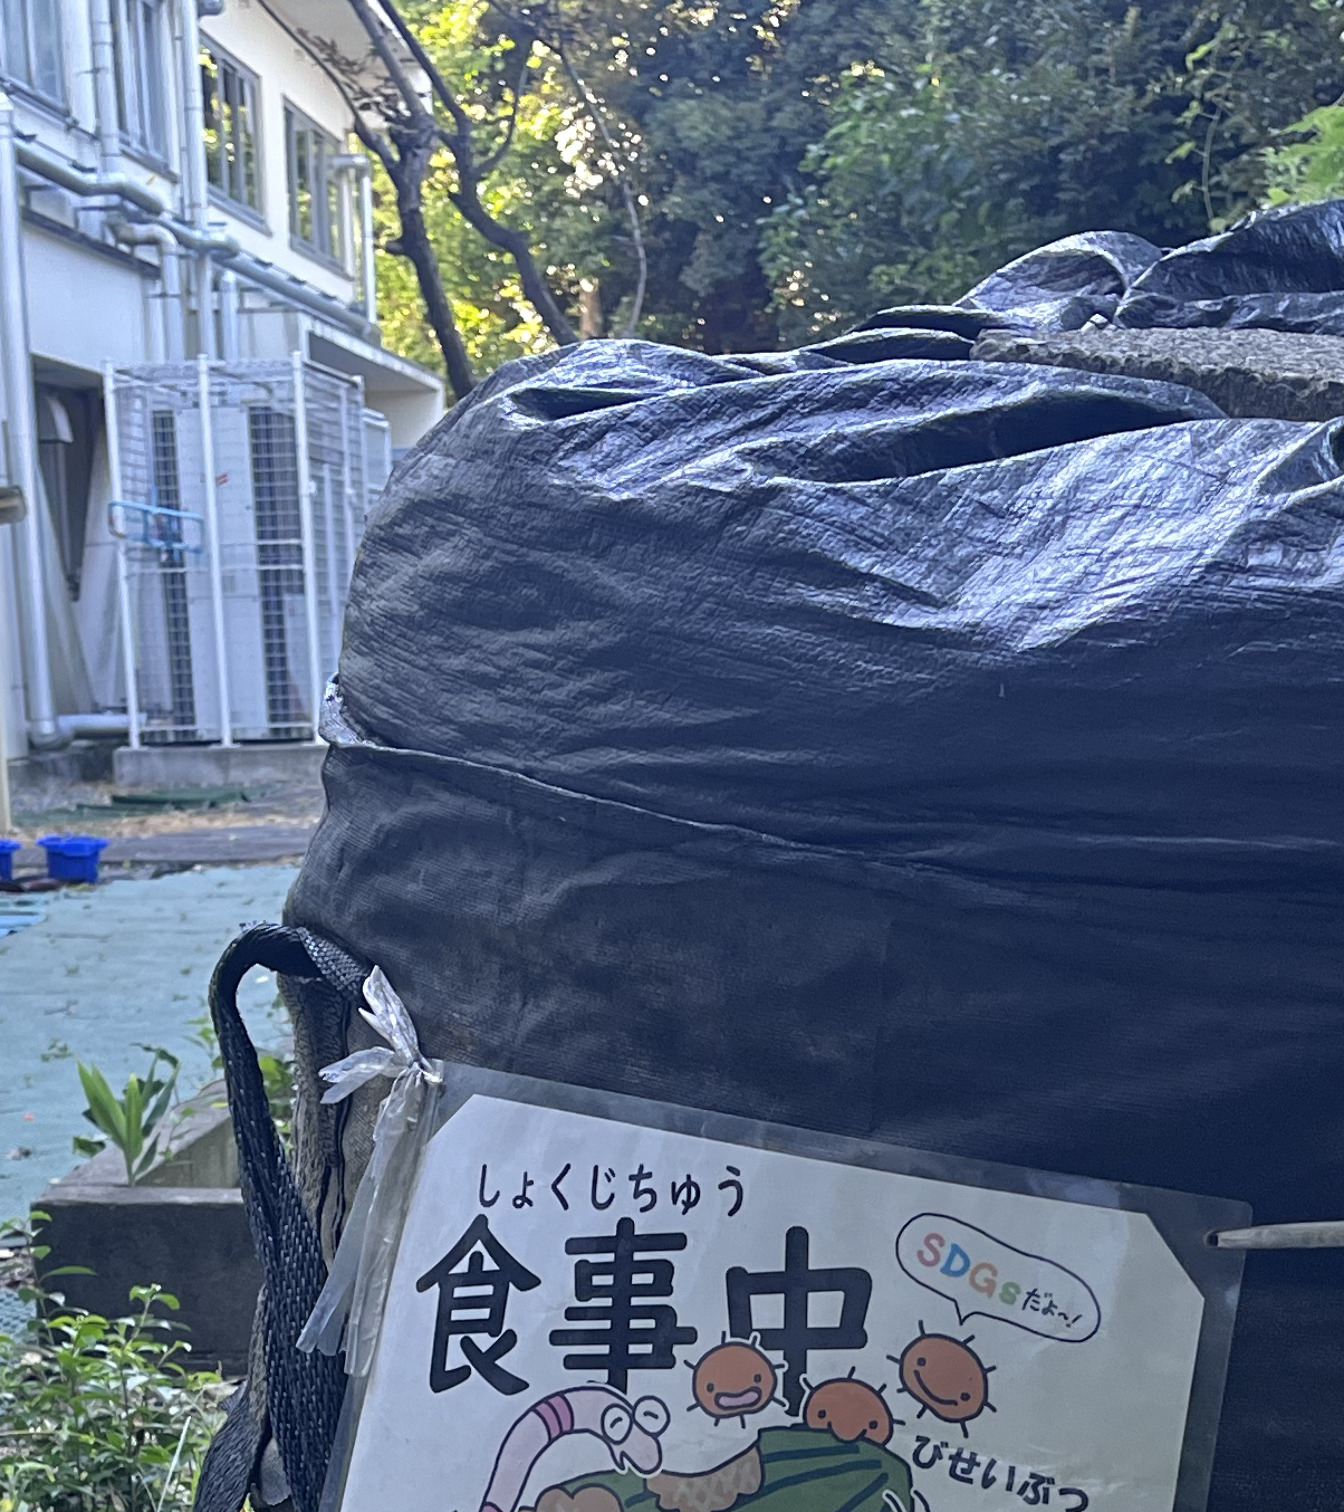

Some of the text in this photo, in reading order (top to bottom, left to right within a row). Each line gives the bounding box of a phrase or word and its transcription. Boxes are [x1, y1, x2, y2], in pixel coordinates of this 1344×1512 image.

[476, 1164, 745, 1216] しょくじちゅう
[416, 1214, 873, 1416] 食事中
